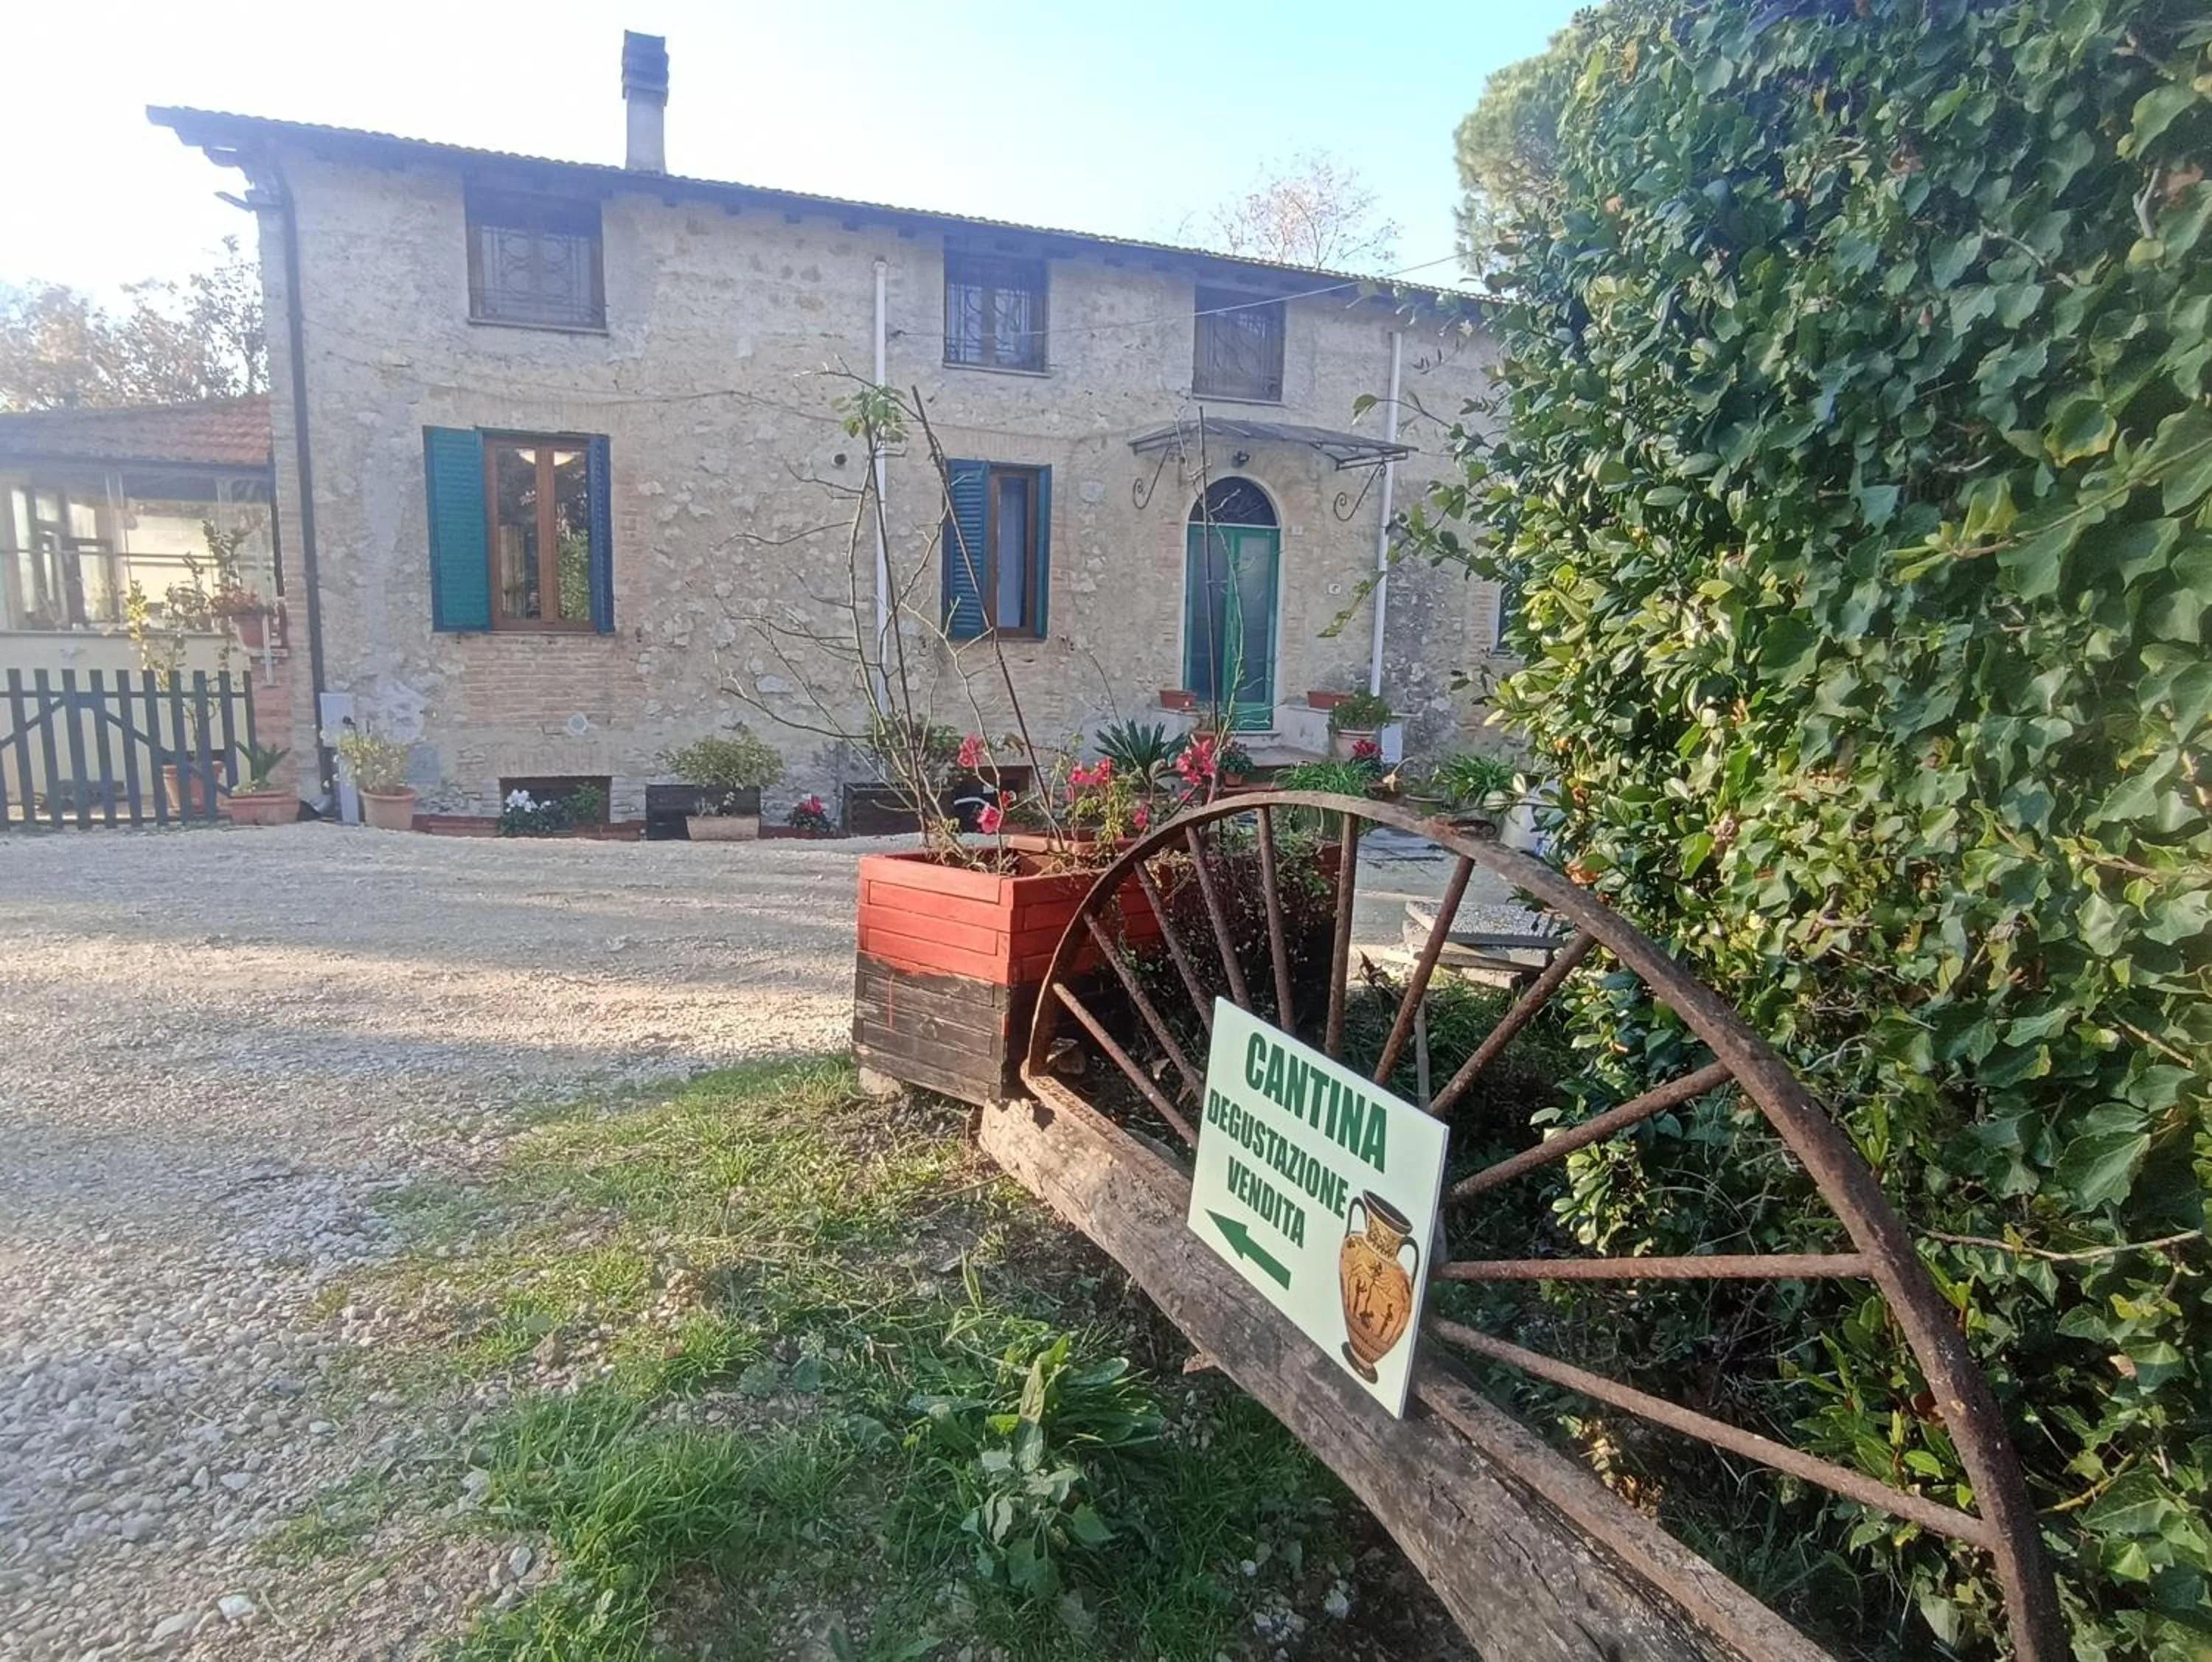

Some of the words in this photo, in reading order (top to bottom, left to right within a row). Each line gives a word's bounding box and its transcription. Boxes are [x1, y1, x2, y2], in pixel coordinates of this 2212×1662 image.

[1207, 1088, 1349, 1220] DEGUSTAZIONE
[1245, 1032, 1387, 1173] CANTINA
[1227, 1155, 1306, 1249] VENDITA
